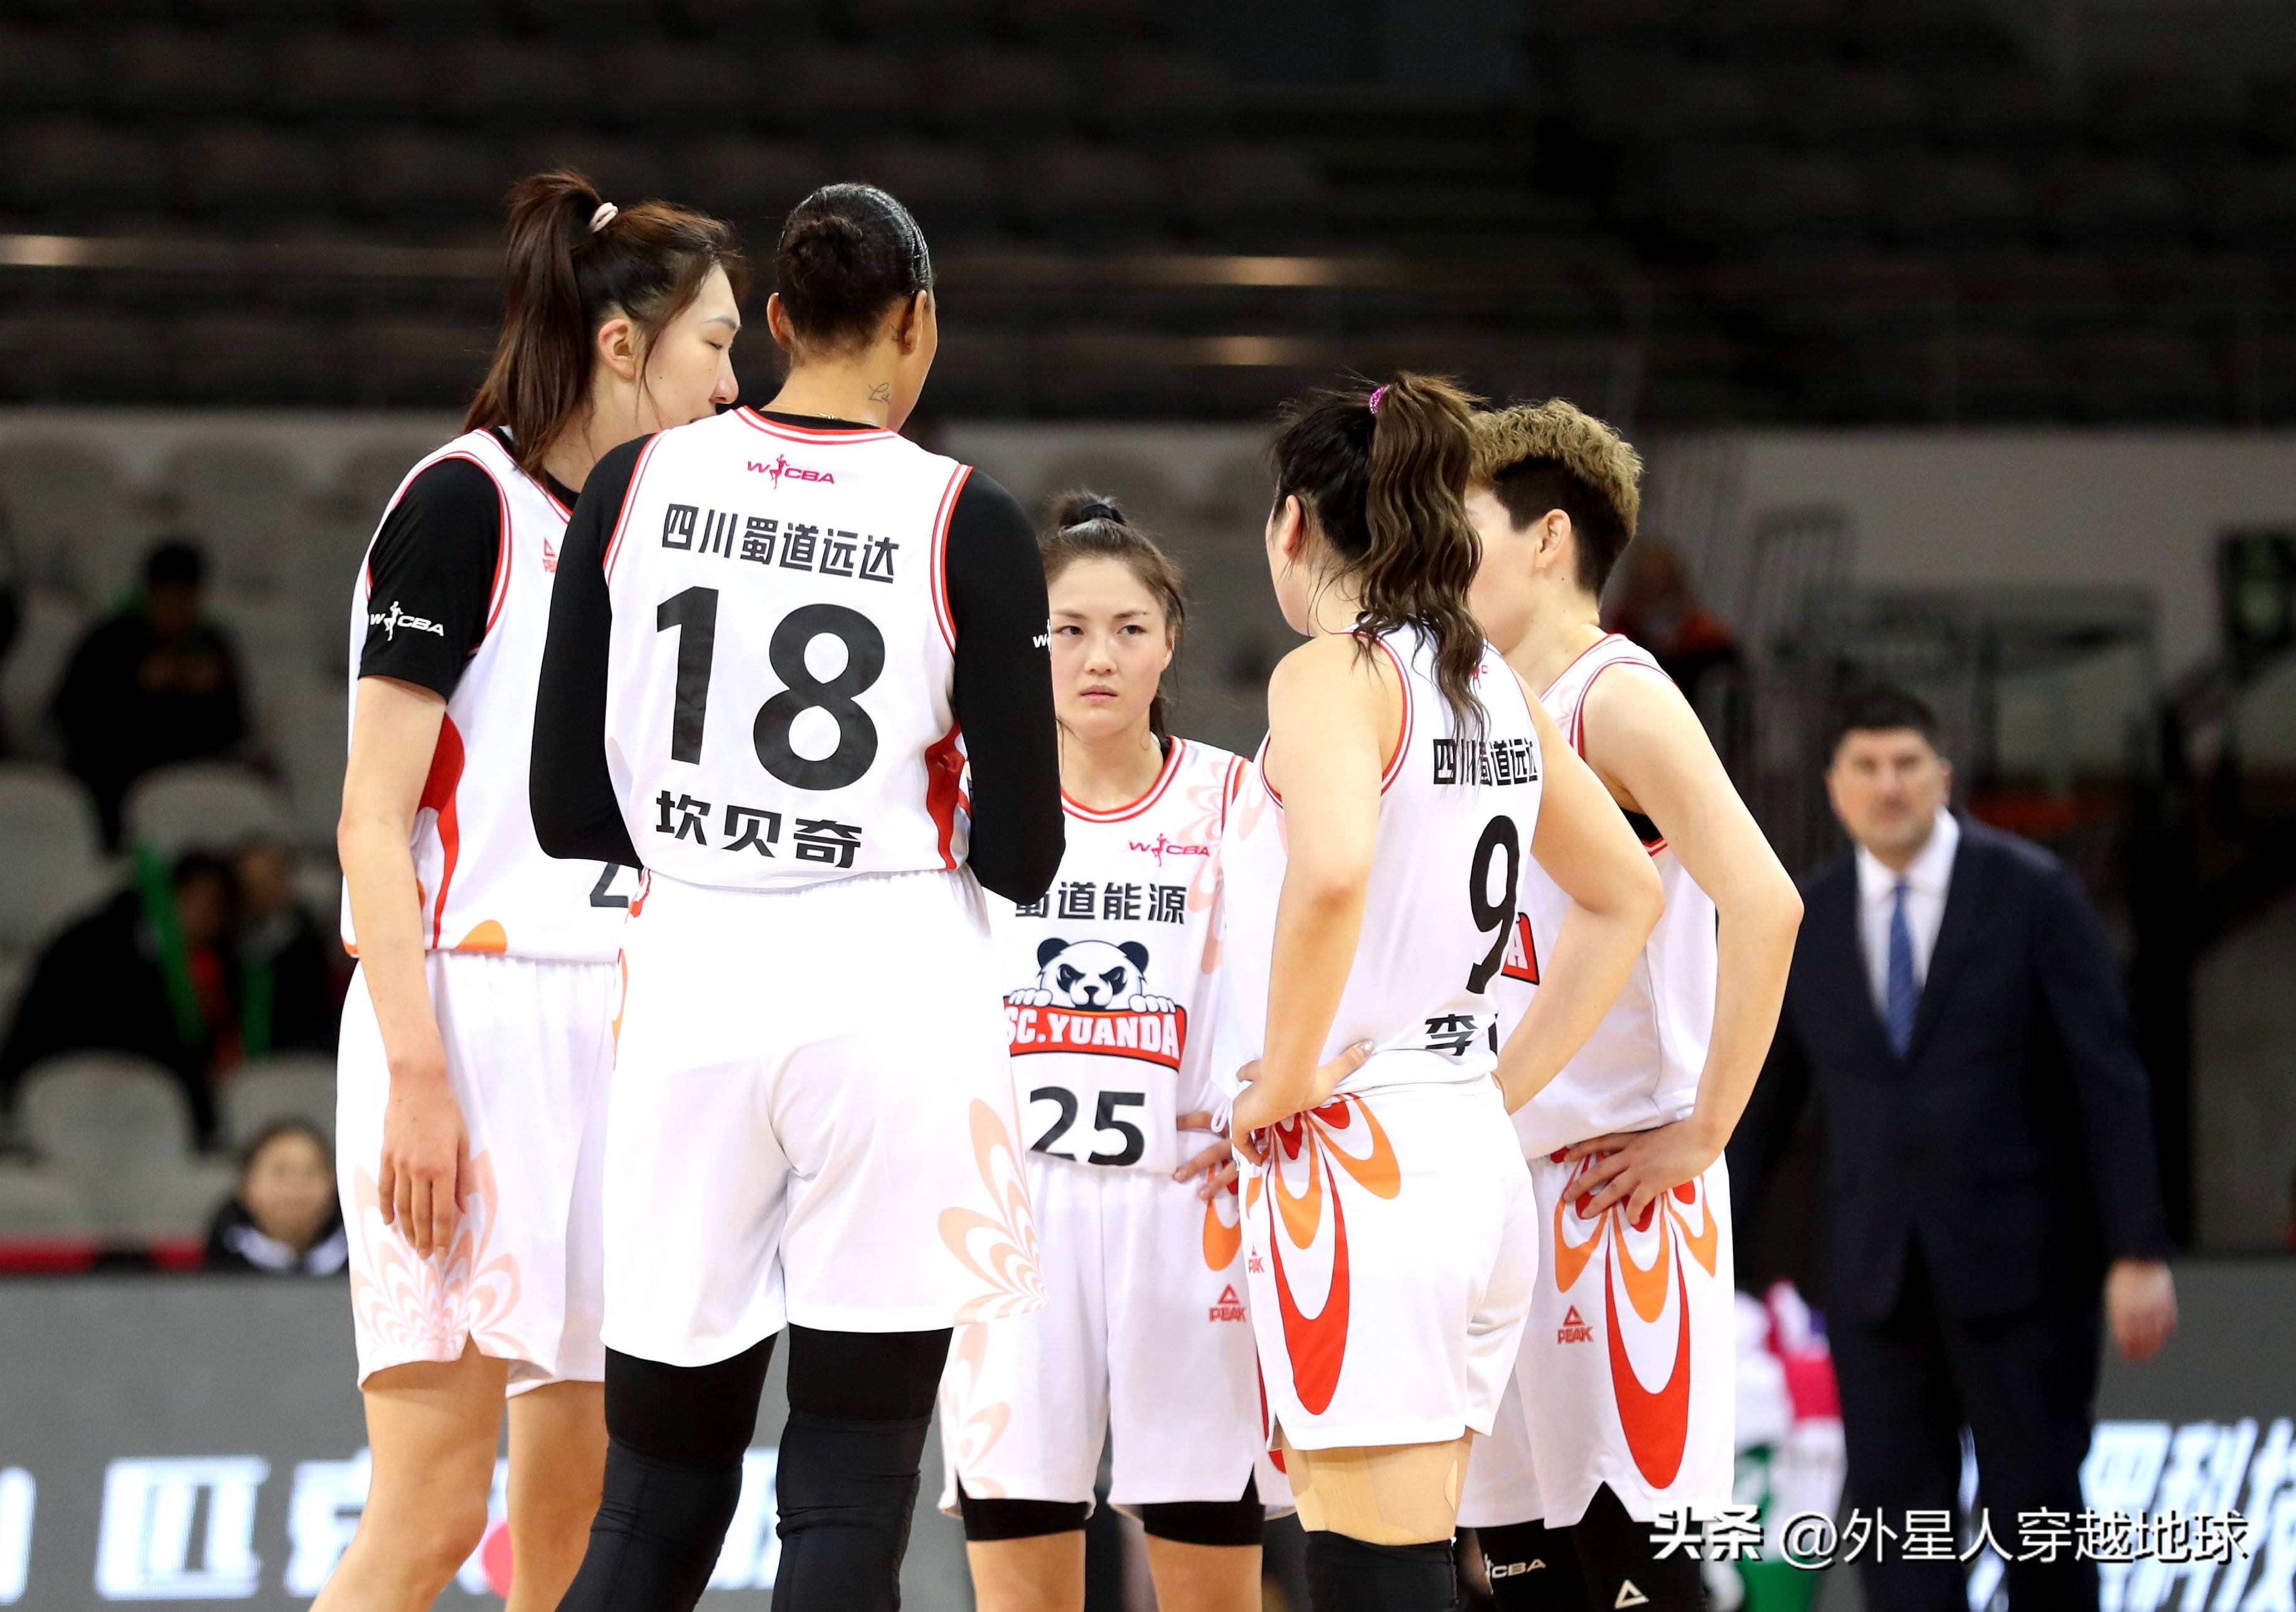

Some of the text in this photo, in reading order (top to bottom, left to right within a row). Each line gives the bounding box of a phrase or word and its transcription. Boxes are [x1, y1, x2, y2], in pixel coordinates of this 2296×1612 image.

[747, 460, 835, 484] WCBA
[661, 503, 900, 584] 四川蜀道远达
[370, 612, 444, 637] WCBA
[656, 585, 886, 791] 18
[656, 789, 863, 869] 坎贝奇
[1466, 814, 1520, 995] 9
[1005, 1005, 1181, 1060] SC.YUANDA
[1425, 1013, 1498, 1057] 李
[1029, 1086, 1146, 1166] 25
[1209, 1306, 1247, 1322] PEAK
[1557, 1325, 1594, 1345] PEAK
[1491, 1558, 1546, 1579] CBA
